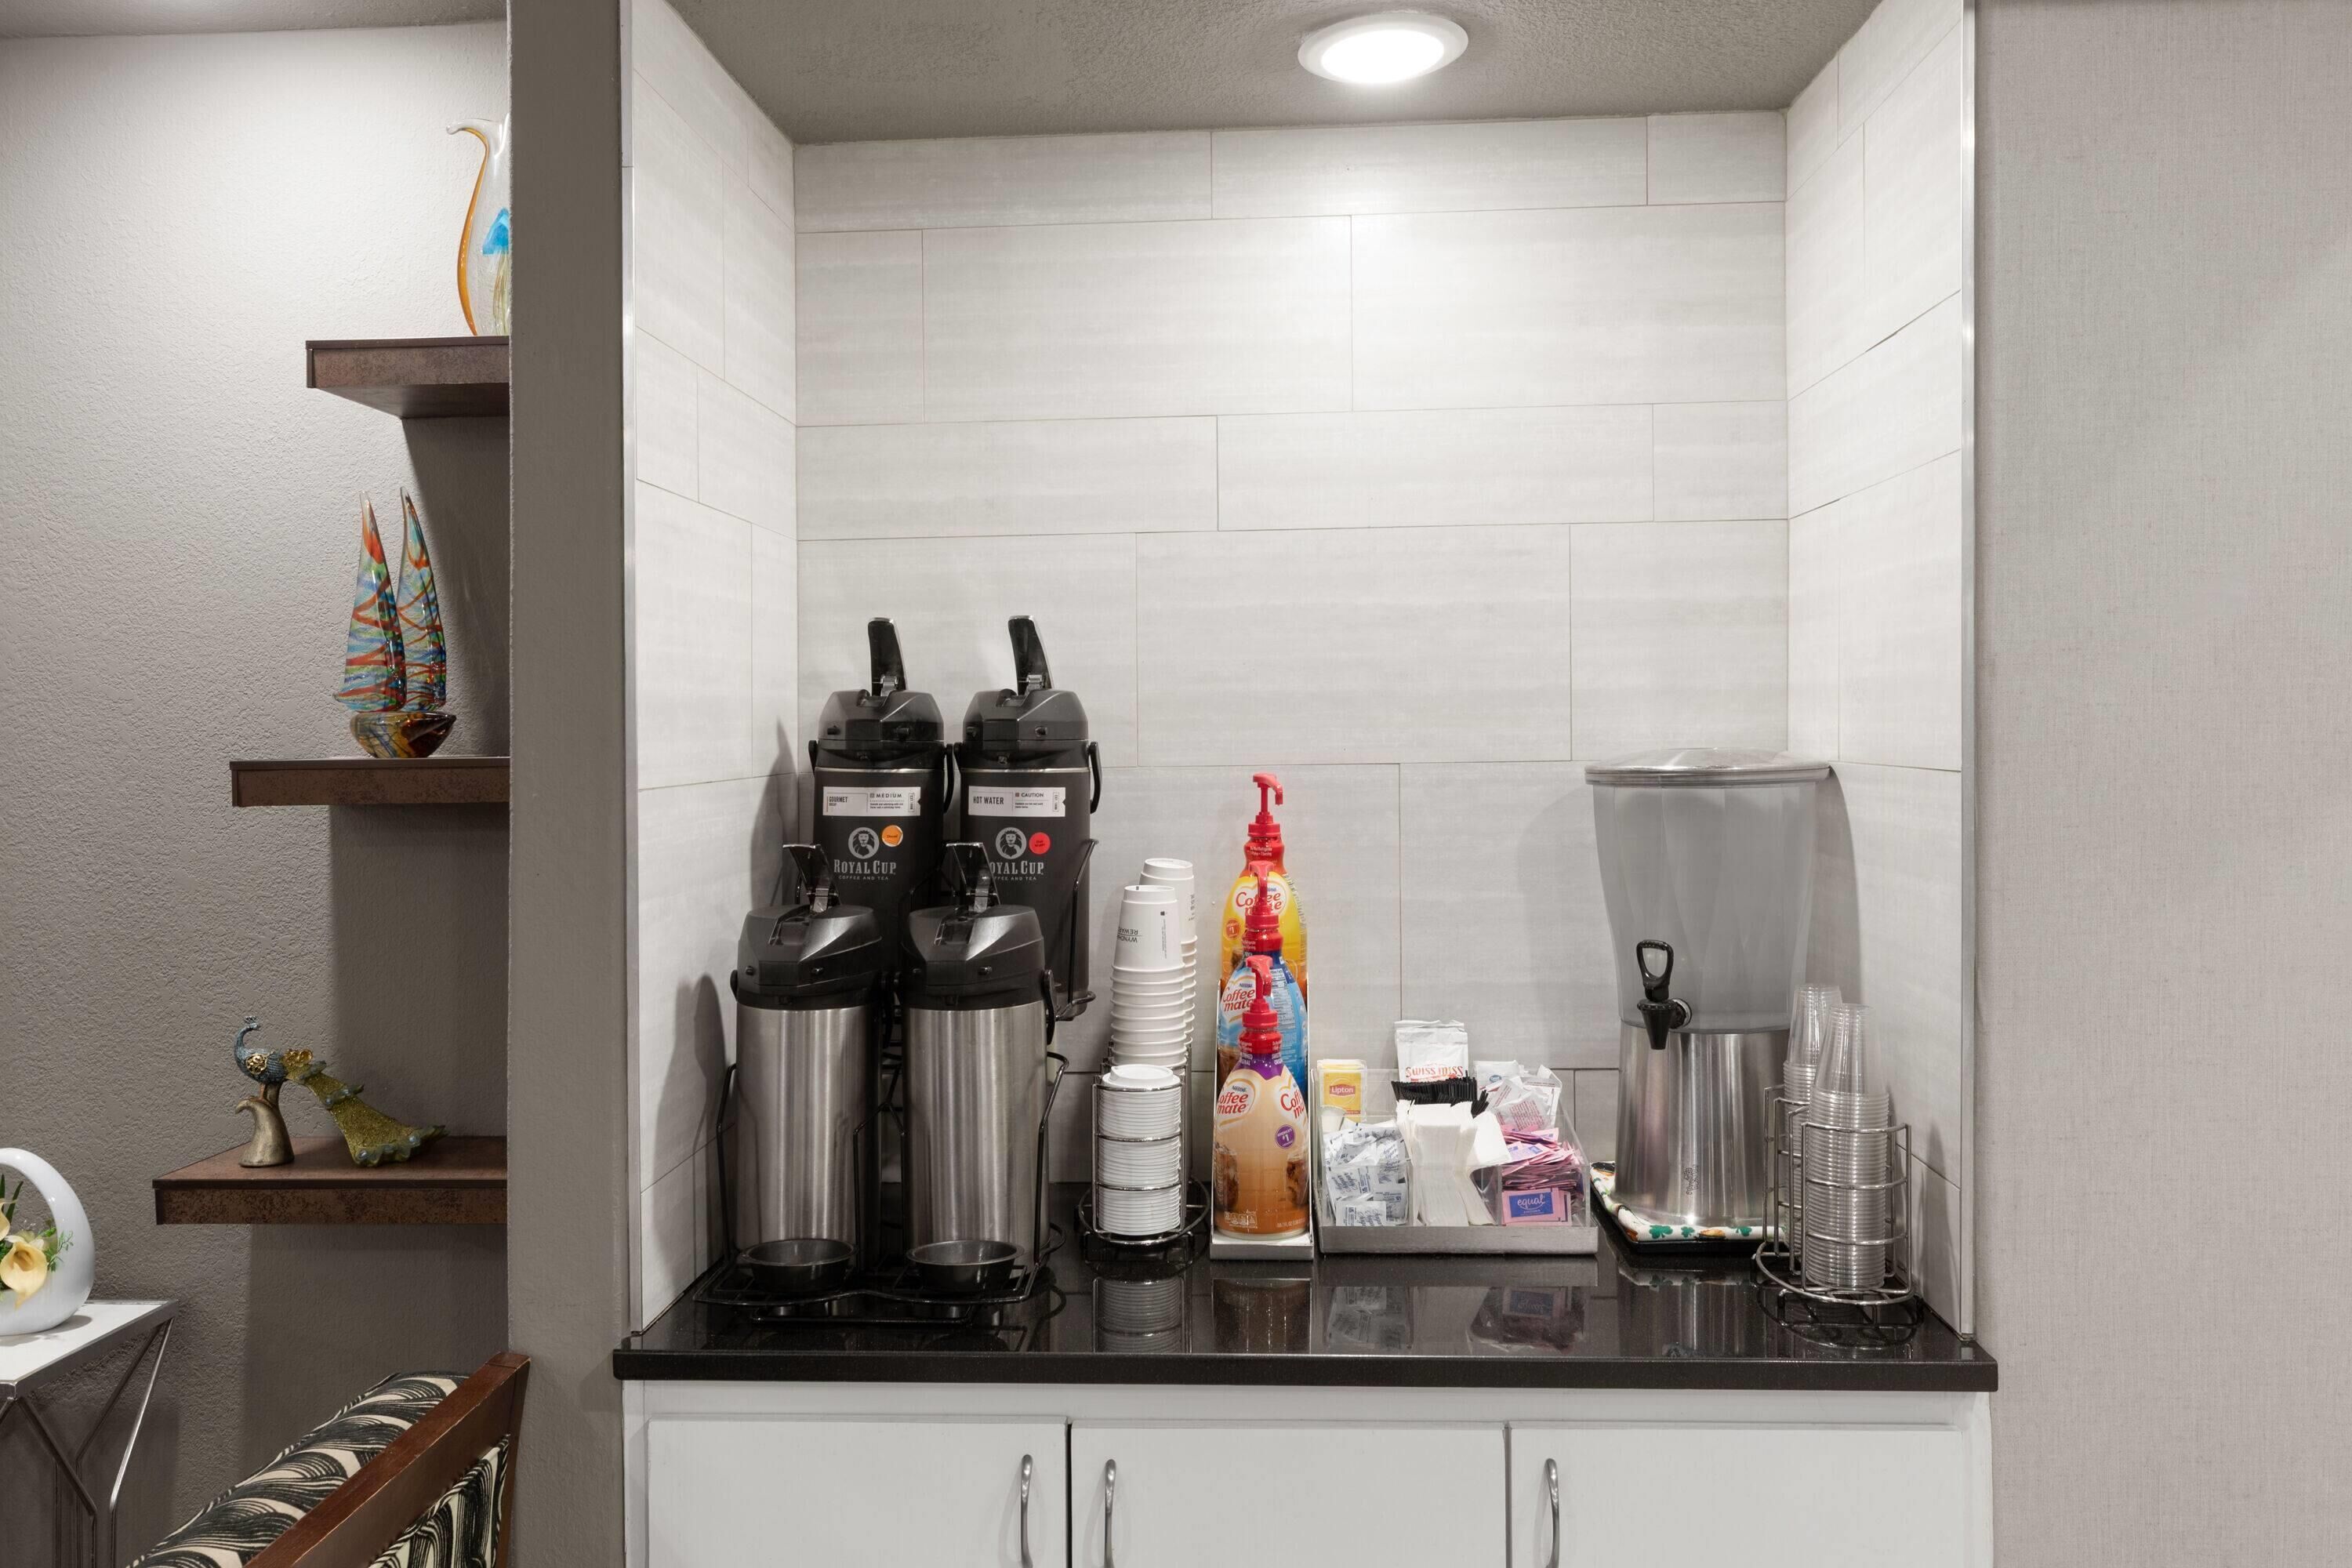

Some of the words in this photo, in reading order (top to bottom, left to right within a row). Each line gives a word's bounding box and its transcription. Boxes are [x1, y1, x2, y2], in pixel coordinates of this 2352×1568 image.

[833, 859, 871, 874] ROYAL
[873, 860, 897, 875] CUP
[989, 862, 1018, 874] OYAL
[1021, 860, 1044, 875] CUP
[1236, 891, 1281, 908] Coee
[1222, 986, 1254, 1003] Coffee
[1218, 1091, 1249, 1104] offee
[1331, 1086, 1354, 1094] Lipton
[1517, 1193, 1546, 1209] equal
